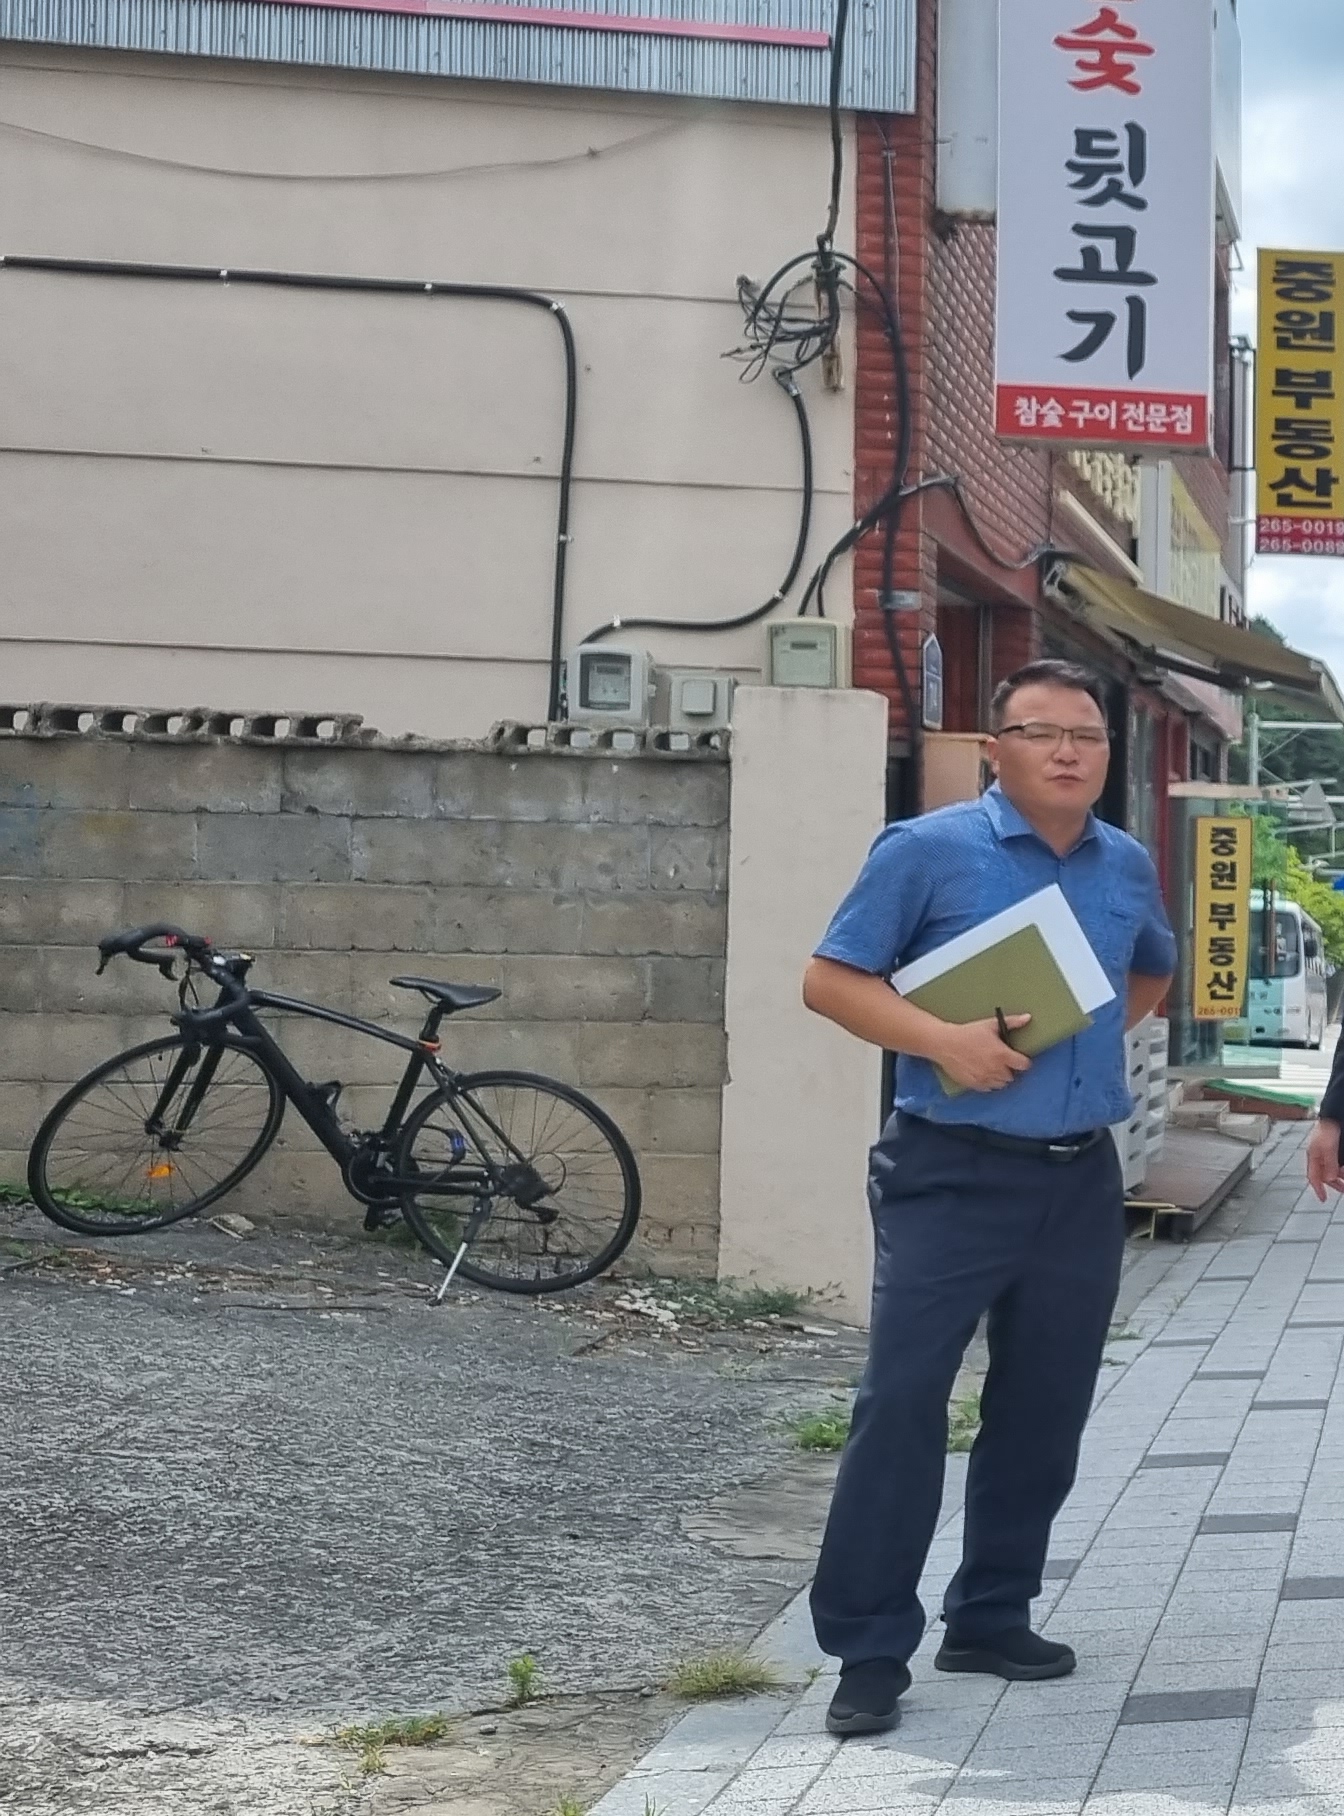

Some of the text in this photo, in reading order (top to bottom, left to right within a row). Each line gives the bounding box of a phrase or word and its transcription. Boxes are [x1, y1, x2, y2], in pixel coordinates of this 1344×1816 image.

[1052, 120, 1158, 380] 뒷고기
[1272, 259, 1336, 353] 중원
[1014, 396, 1193, 435] 참숯 구이 전문점
[1269, 368, 1340, 510] 부동산
[1210, 826, 1238, 891] 중원
[1207, 902, 1238, 1001] 부동산
